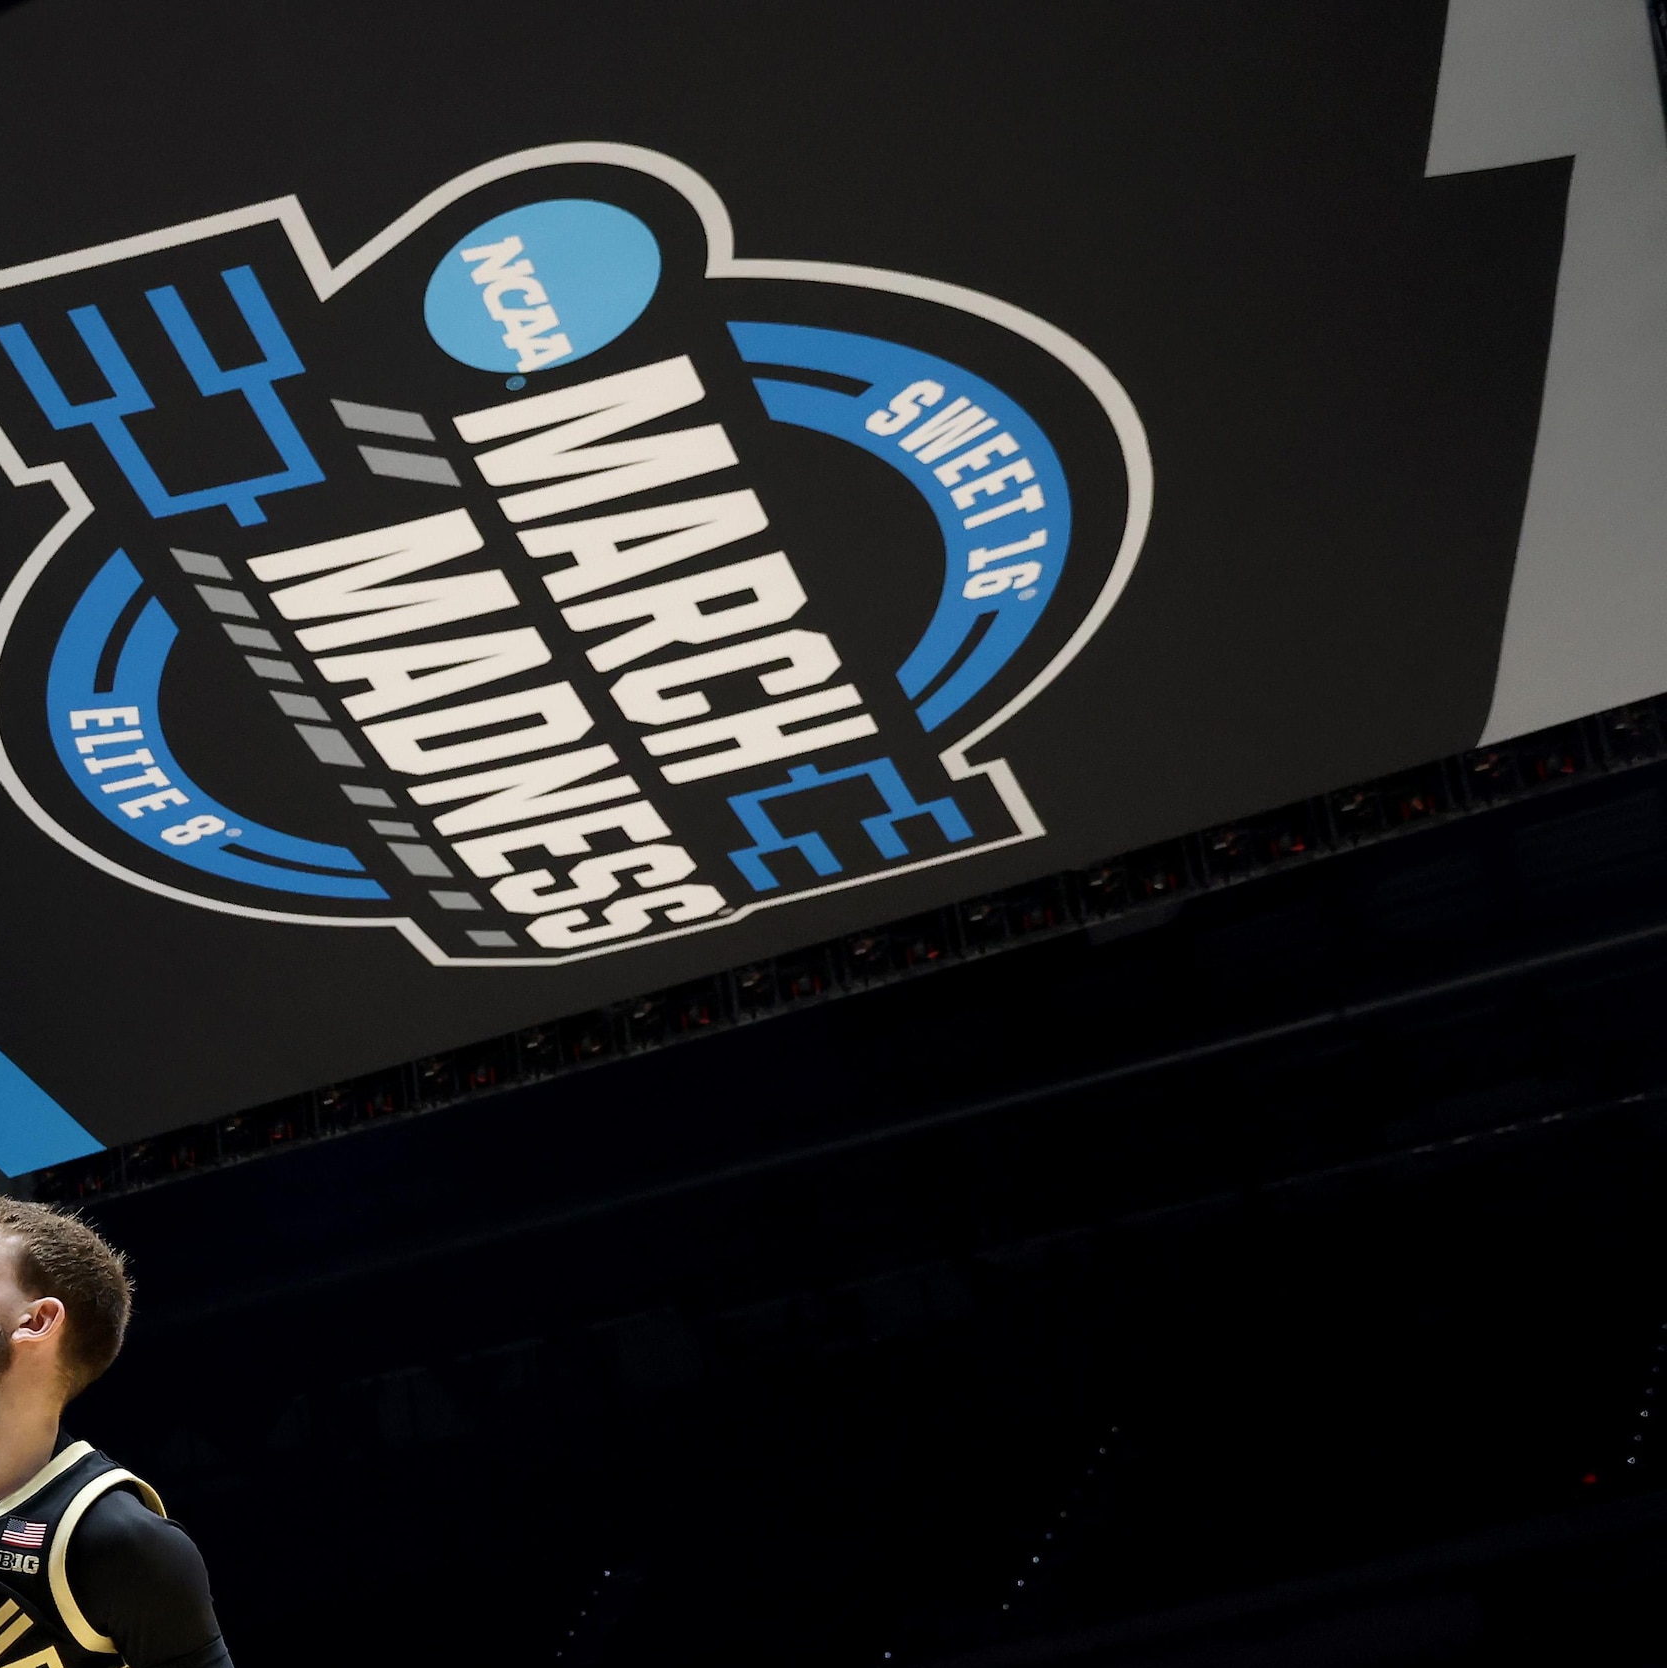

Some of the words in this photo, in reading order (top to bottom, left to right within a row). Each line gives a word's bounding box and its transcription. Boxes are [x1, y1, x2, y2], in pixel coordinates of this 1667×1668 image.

[459, 234, 574, 374] NCAA
[452, 353, 879, 786] MARCH
[865, 378, 1046, 530] SWEET
[962, 528, 1049, 601] 16
[69, 705, 190, 820] ELITE
[160, 814, 227, 847] 8
[246, 507, 729, 950] MADNESS
